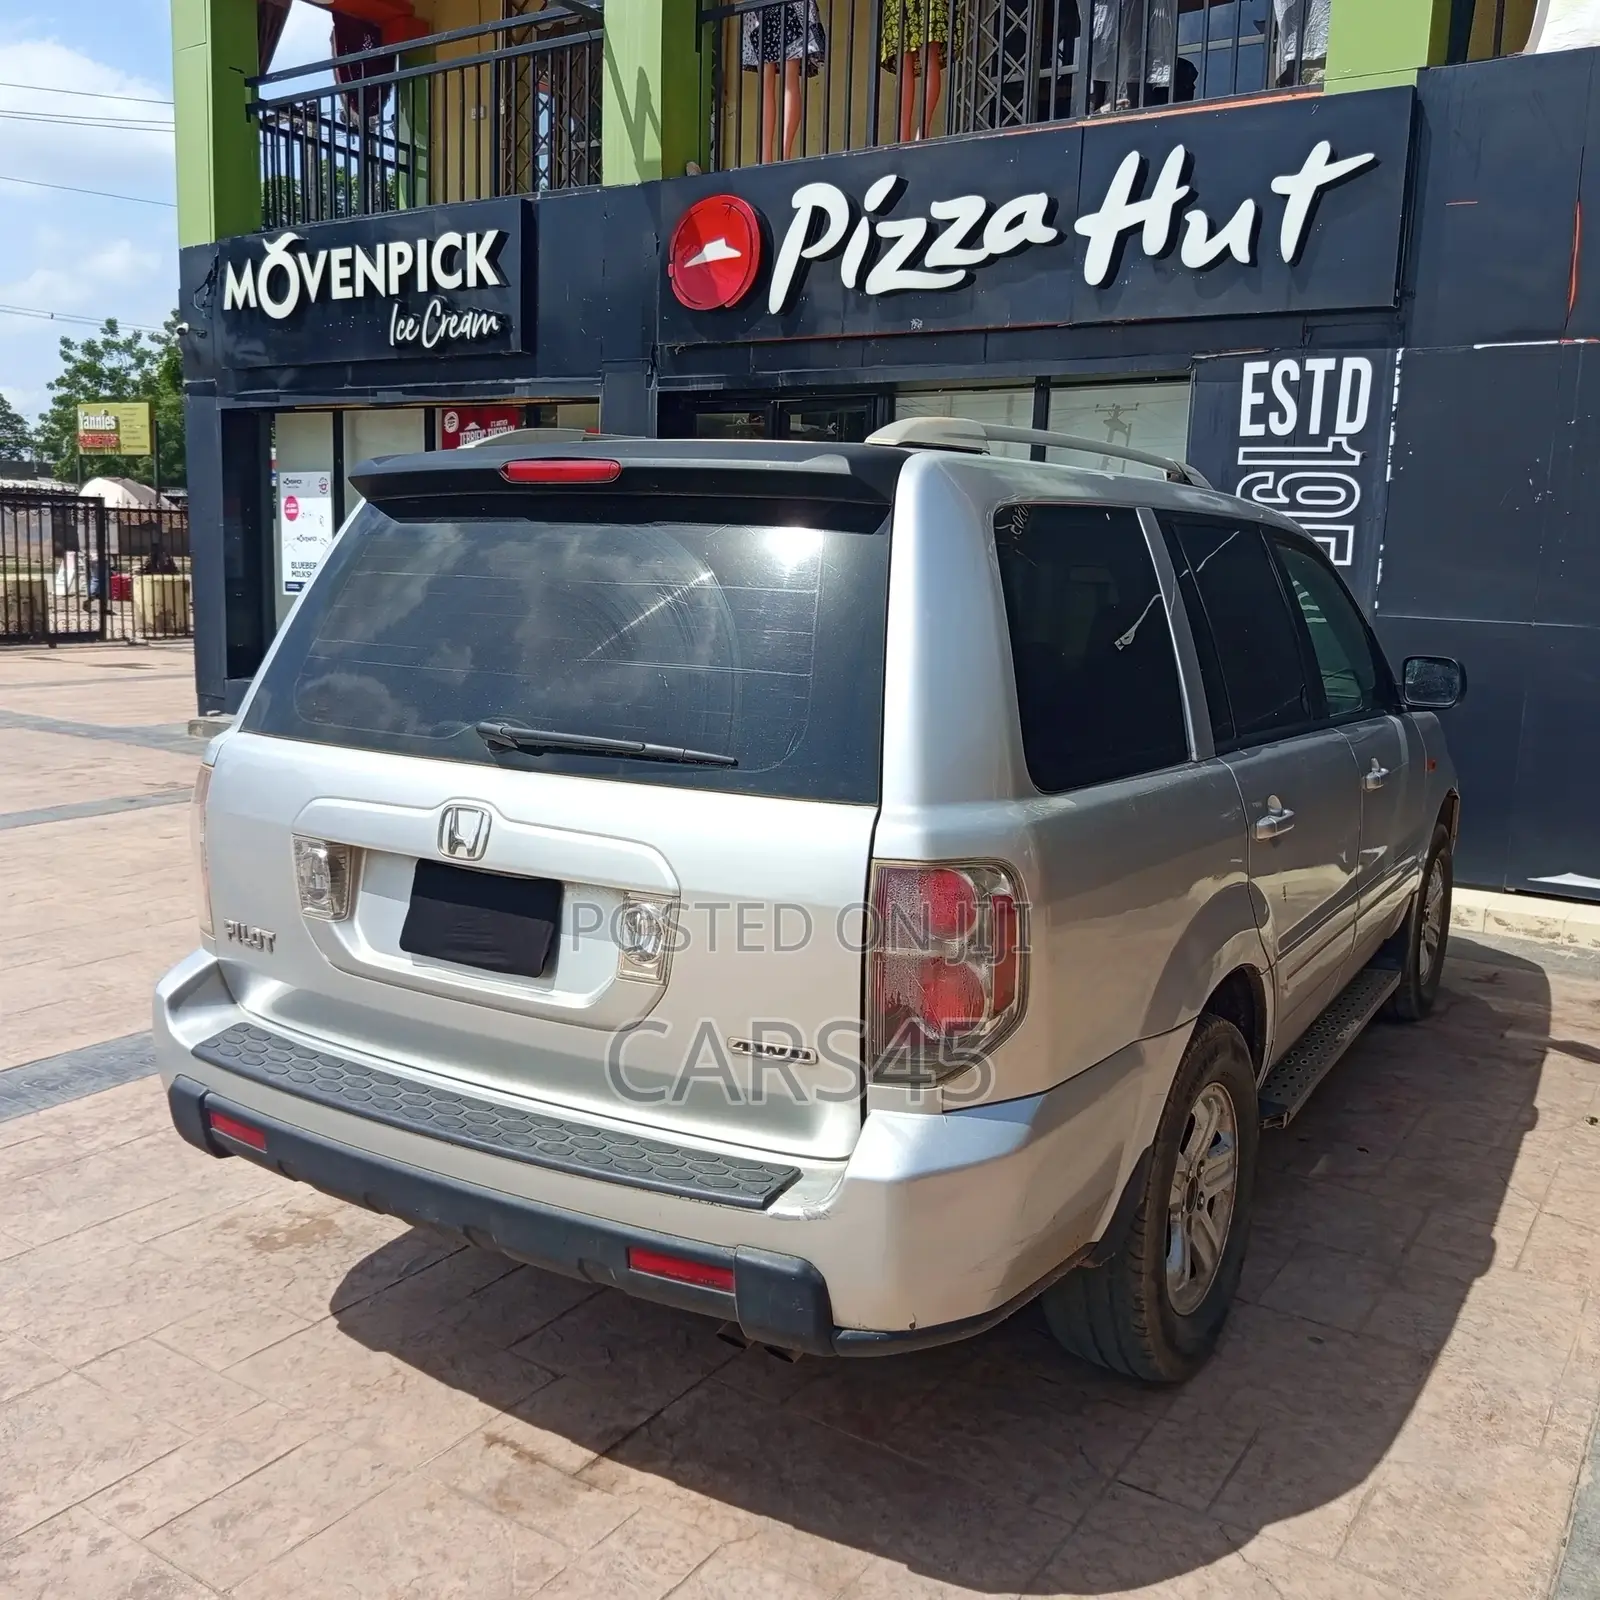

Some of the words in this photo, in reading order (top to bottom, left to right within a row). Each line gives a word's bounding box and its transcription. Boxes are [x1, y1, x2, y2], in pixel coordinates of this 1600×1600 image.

[768, 174, 1059, 315] Pizza
[1074, 140, 1376, 288] Hut
[390, 303, 420, 348] Ice
[421, 299, 500, 349] Cream
[1239, 356, 1373, 437] ESTD
[223, 918, 276, 953] PILOT
